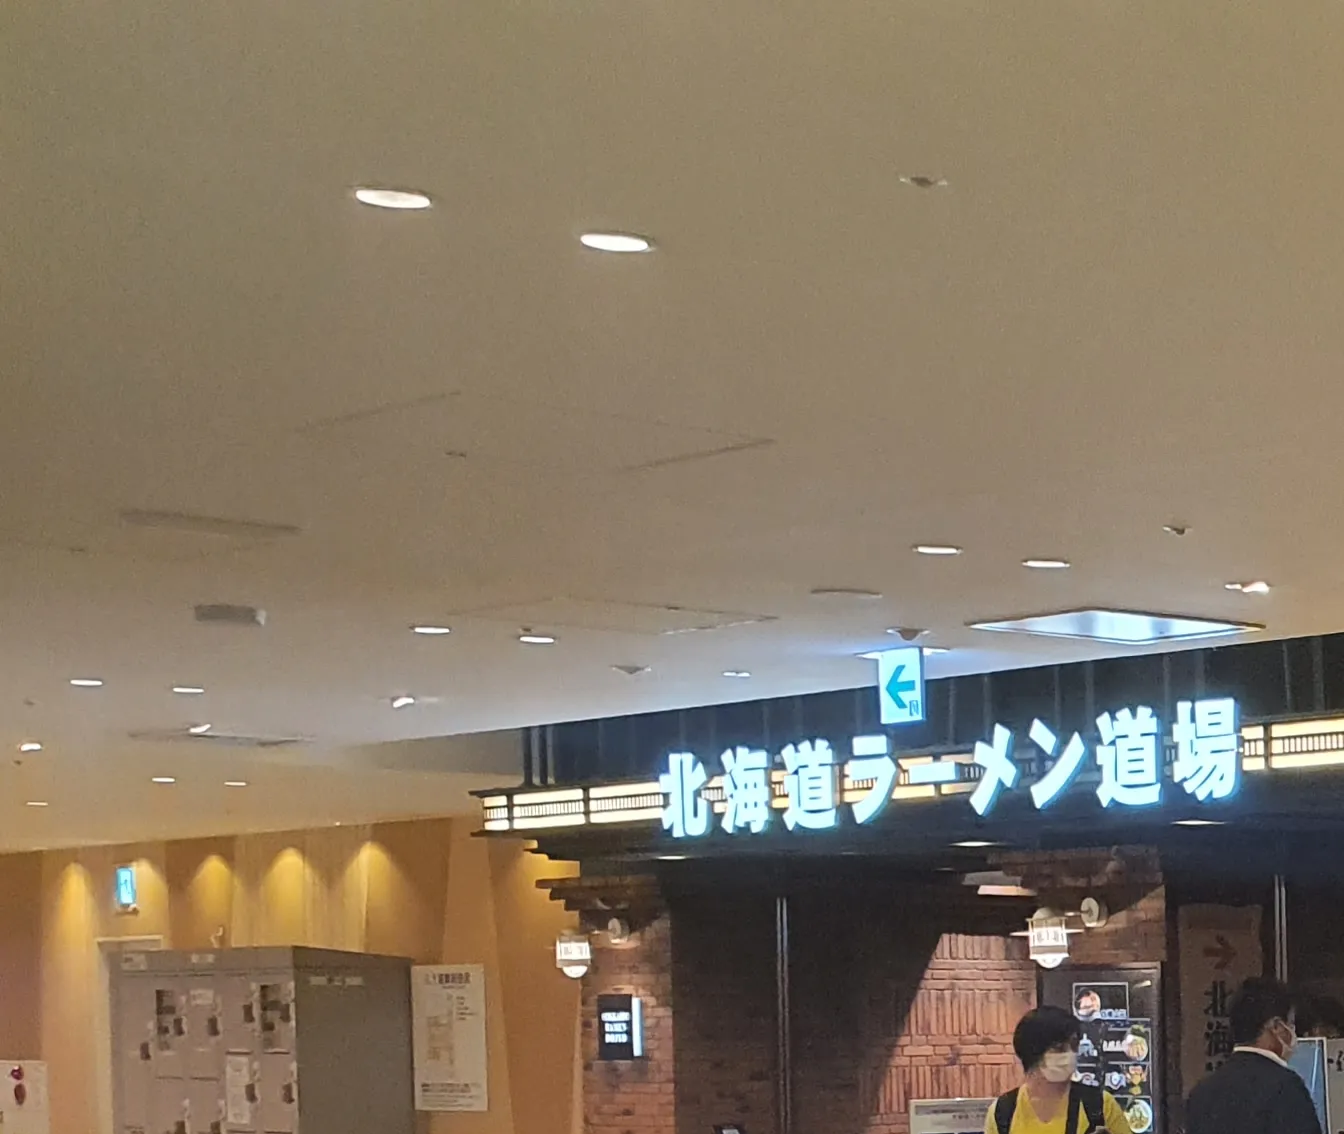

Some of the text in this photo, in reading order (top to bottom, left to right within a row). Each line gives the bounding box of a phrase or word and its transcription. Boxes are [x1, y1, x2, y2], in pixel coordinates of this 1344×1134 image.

[659, 696, 1244, 838] 北海道ラーメン道場
